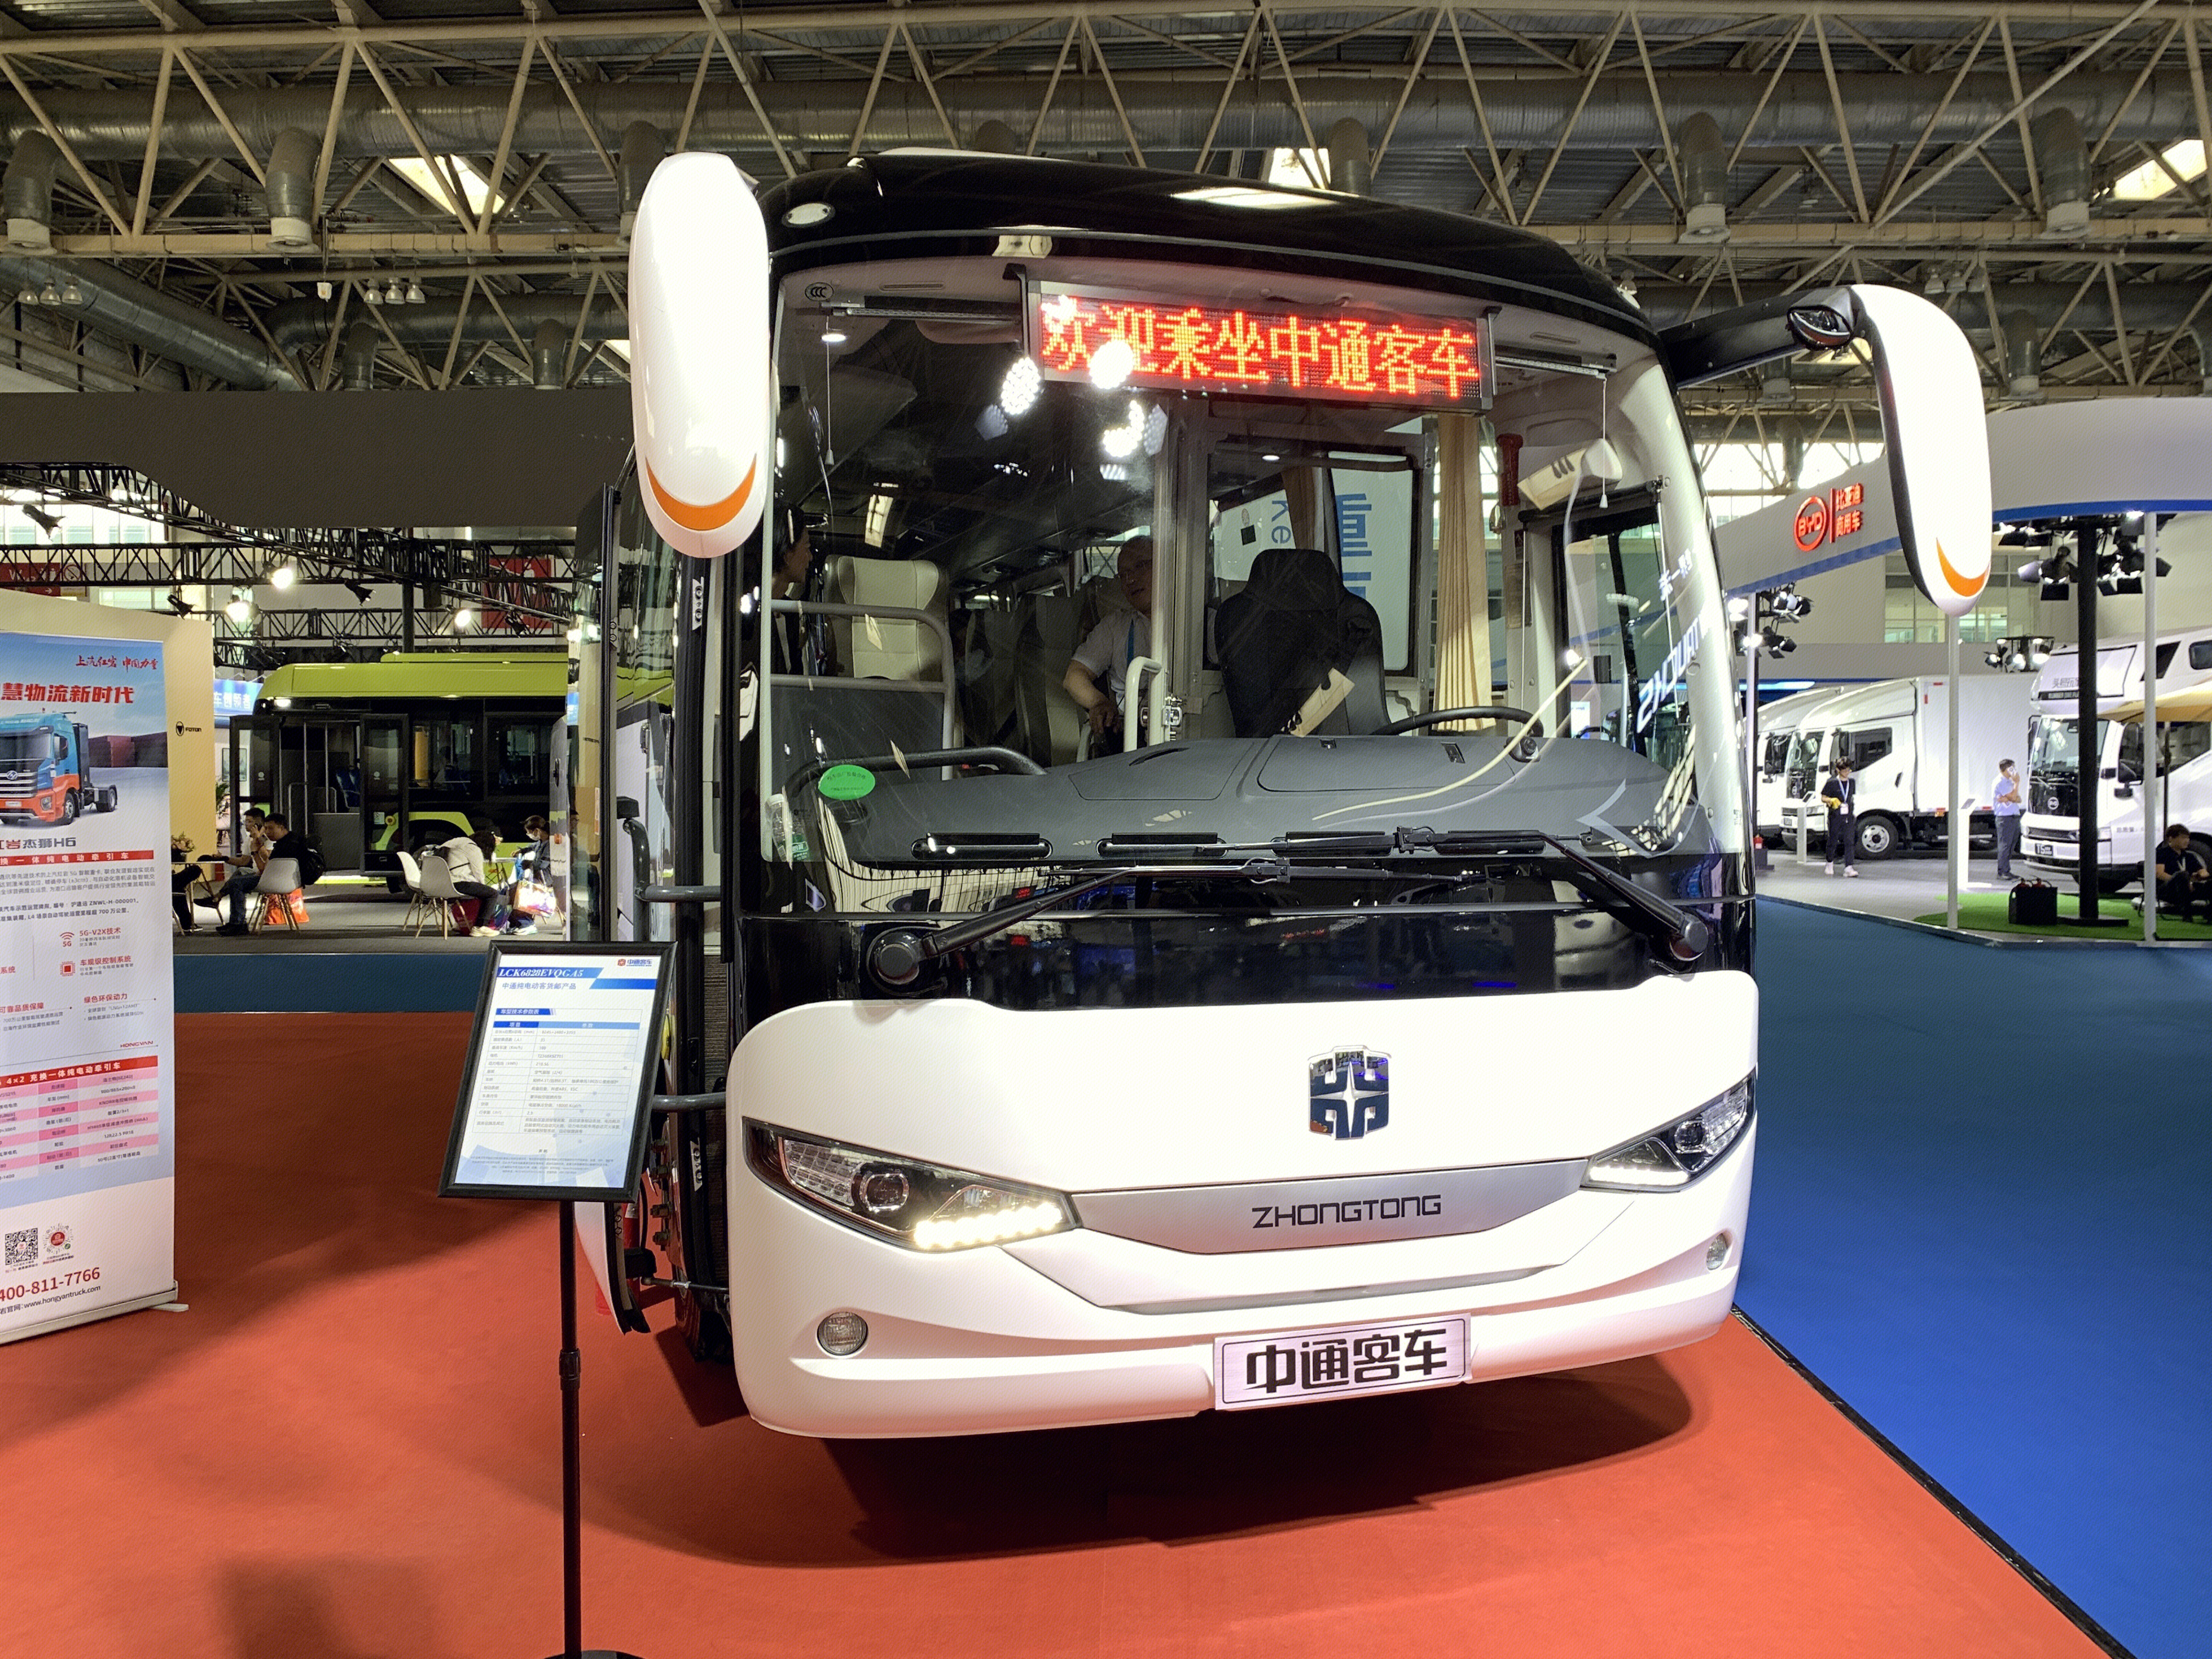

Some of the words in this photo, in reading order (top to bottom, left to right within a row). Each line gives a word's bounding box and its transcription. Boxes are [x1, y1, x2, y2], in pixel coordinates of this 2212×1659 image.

[1042, 297, 1479, 398] 欢迎乘坐中通客车
[1836, 483, 1863, 511] 比亚迪
[1798, 511, 1823, 537] BYD
[1836, 510, 1862, 538] 商用车
[1, 682, 134, 703] 慧物流新时代
[499, 969, 584, 978] LCK6828EVQGA5
[1252, 1194, 1441, 1229] ZHONGTONG
[0, 1267, 100, 1302] 400-811-7766
[1243, 1328, 1448, 1394] 中通客车
